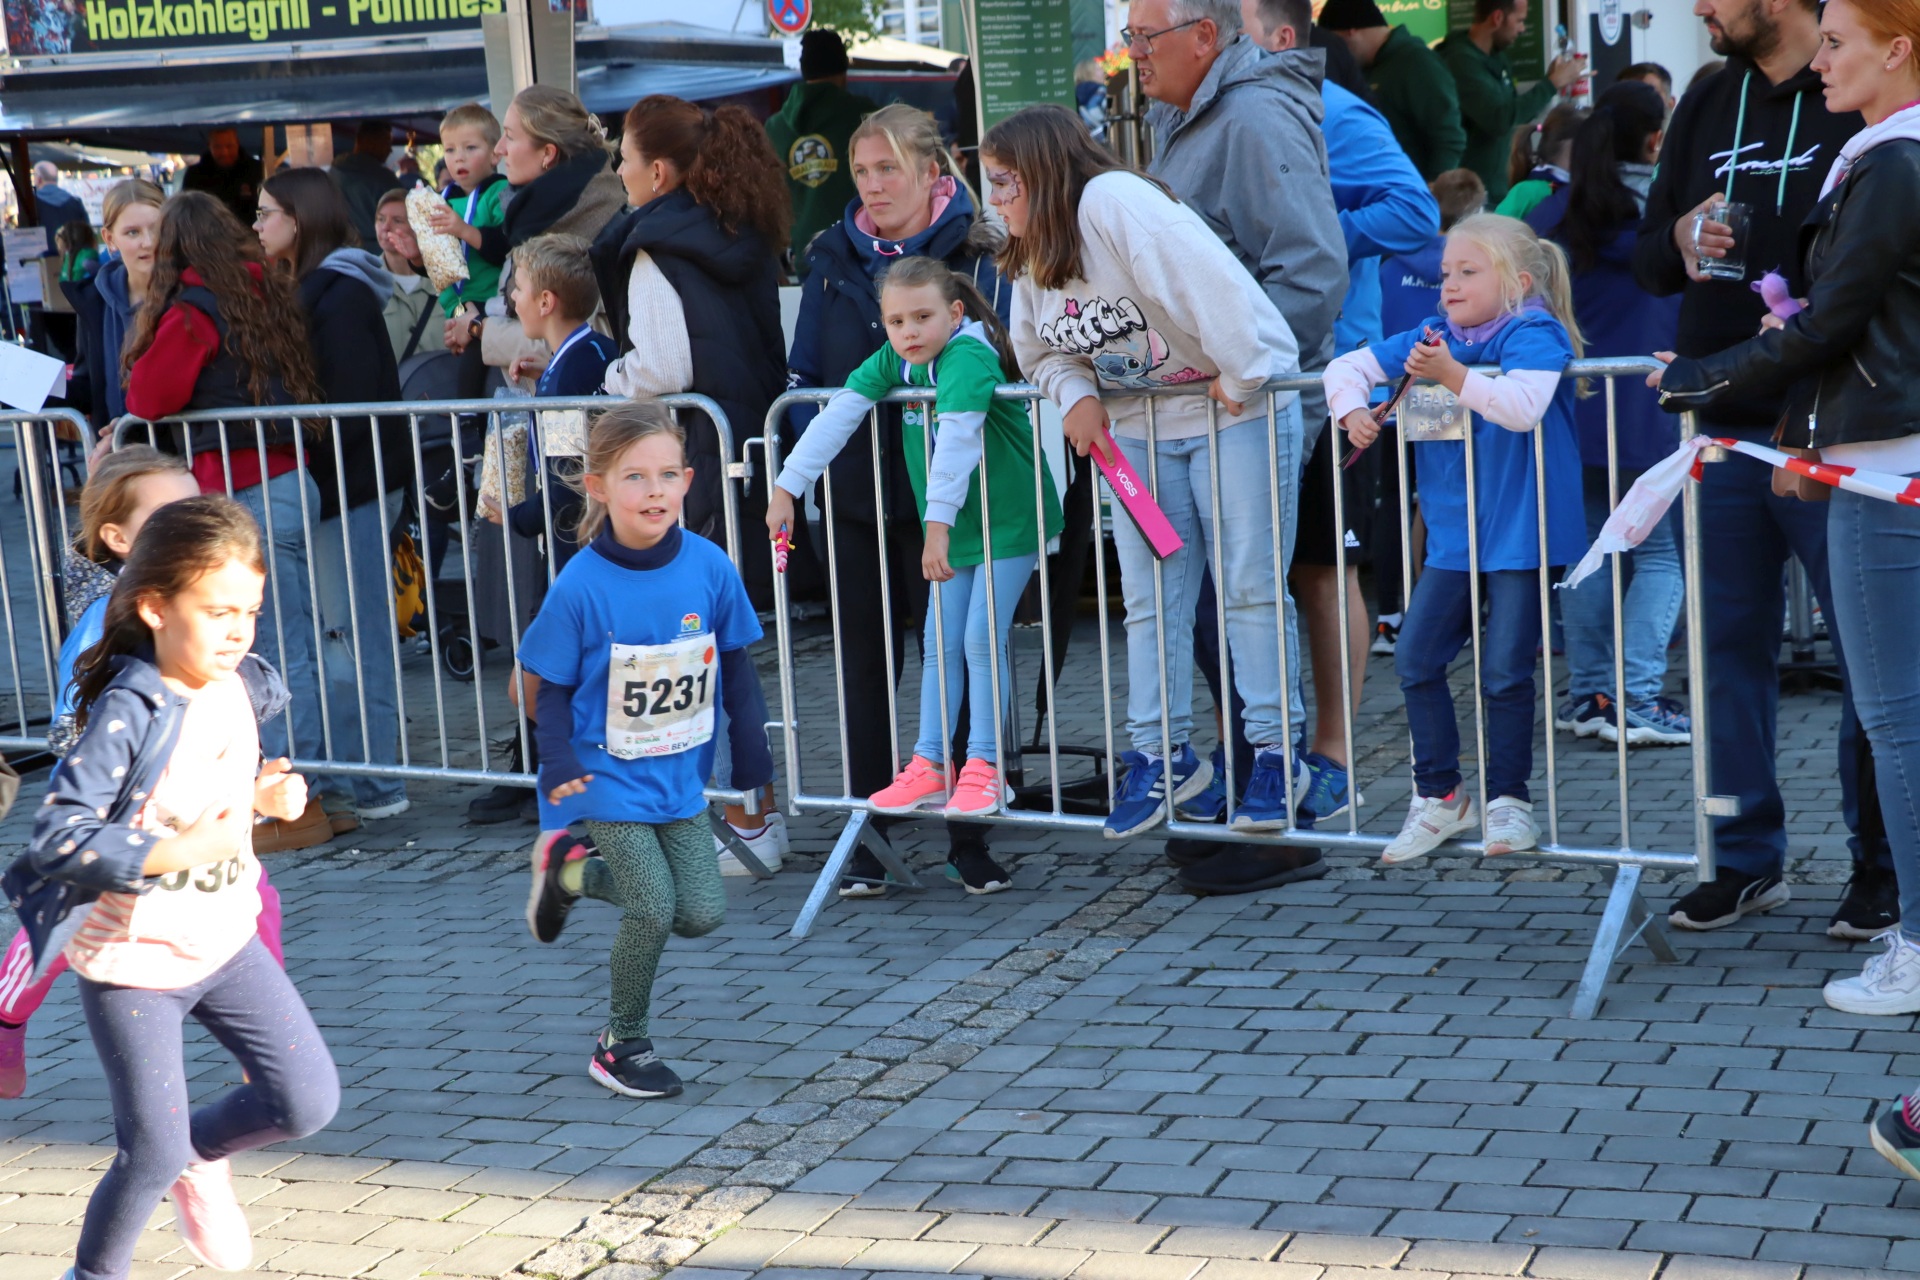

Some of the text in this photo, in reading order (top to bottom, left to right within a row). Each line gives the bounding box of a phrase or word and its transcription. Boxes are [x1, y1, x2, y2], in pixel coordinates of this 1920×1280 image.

[85, 0, 311, 41] Holzkohlegrill
[1116, 467, 1138, 497] VOSS
[623, 668, 709, 718] 5231
